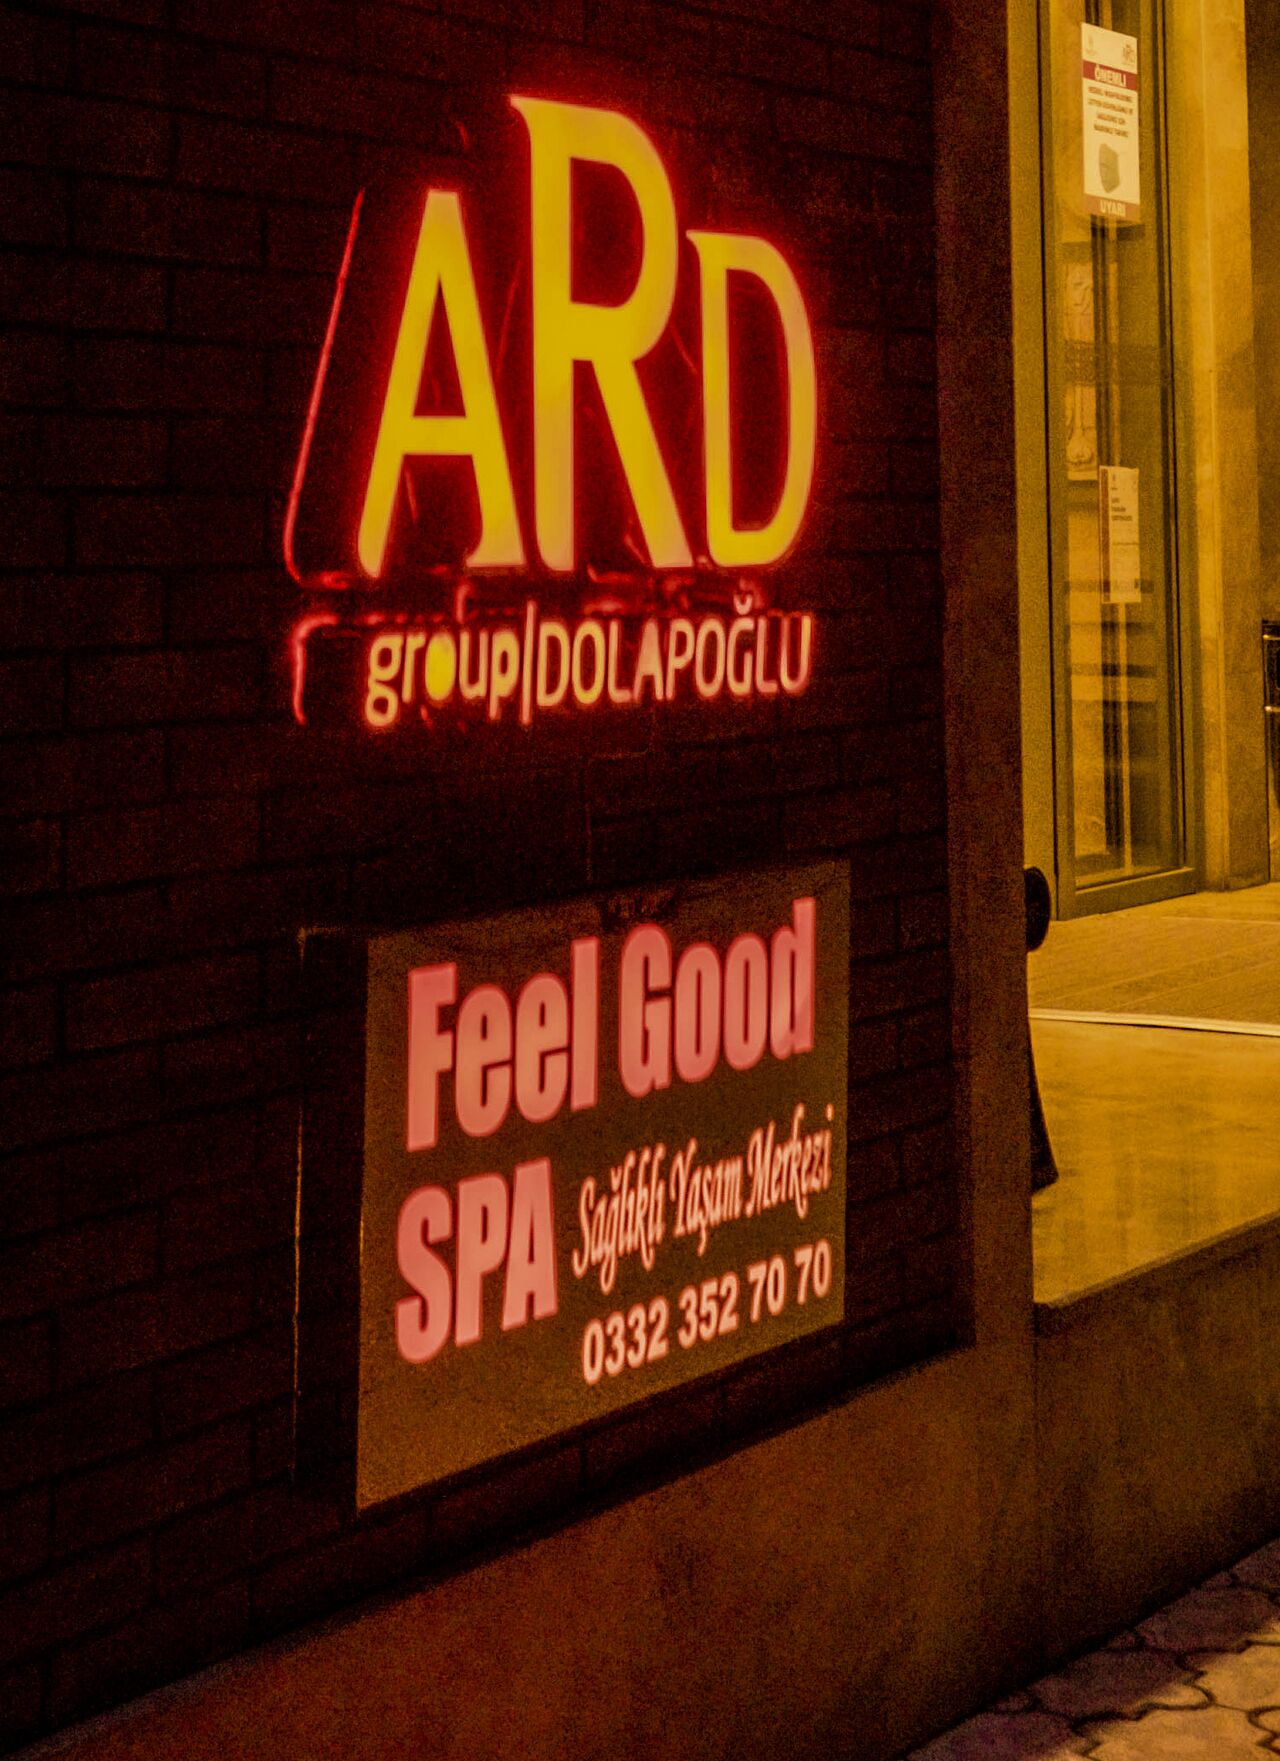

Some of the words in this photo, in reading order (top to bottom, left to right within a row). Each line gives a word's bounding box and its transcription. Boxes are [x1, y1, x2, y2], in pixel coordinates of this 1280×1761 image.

[358, 94, 817, 578] ARD
[407, 936, 600, 1152] Feel
[620, 896, 816, 1098] Good
[395, 1157, 559, 1364] SPA
[669, 1137, 744, 1257] Yaşam
[745, 1102, 834, 1219] Merkezi
[582, 1296, 670, 1386] 0332
[677, 1271, 740, 1349] 352
[746, 1253, 787, 1323] 70
[794, 1239, 833, 1305] 70
